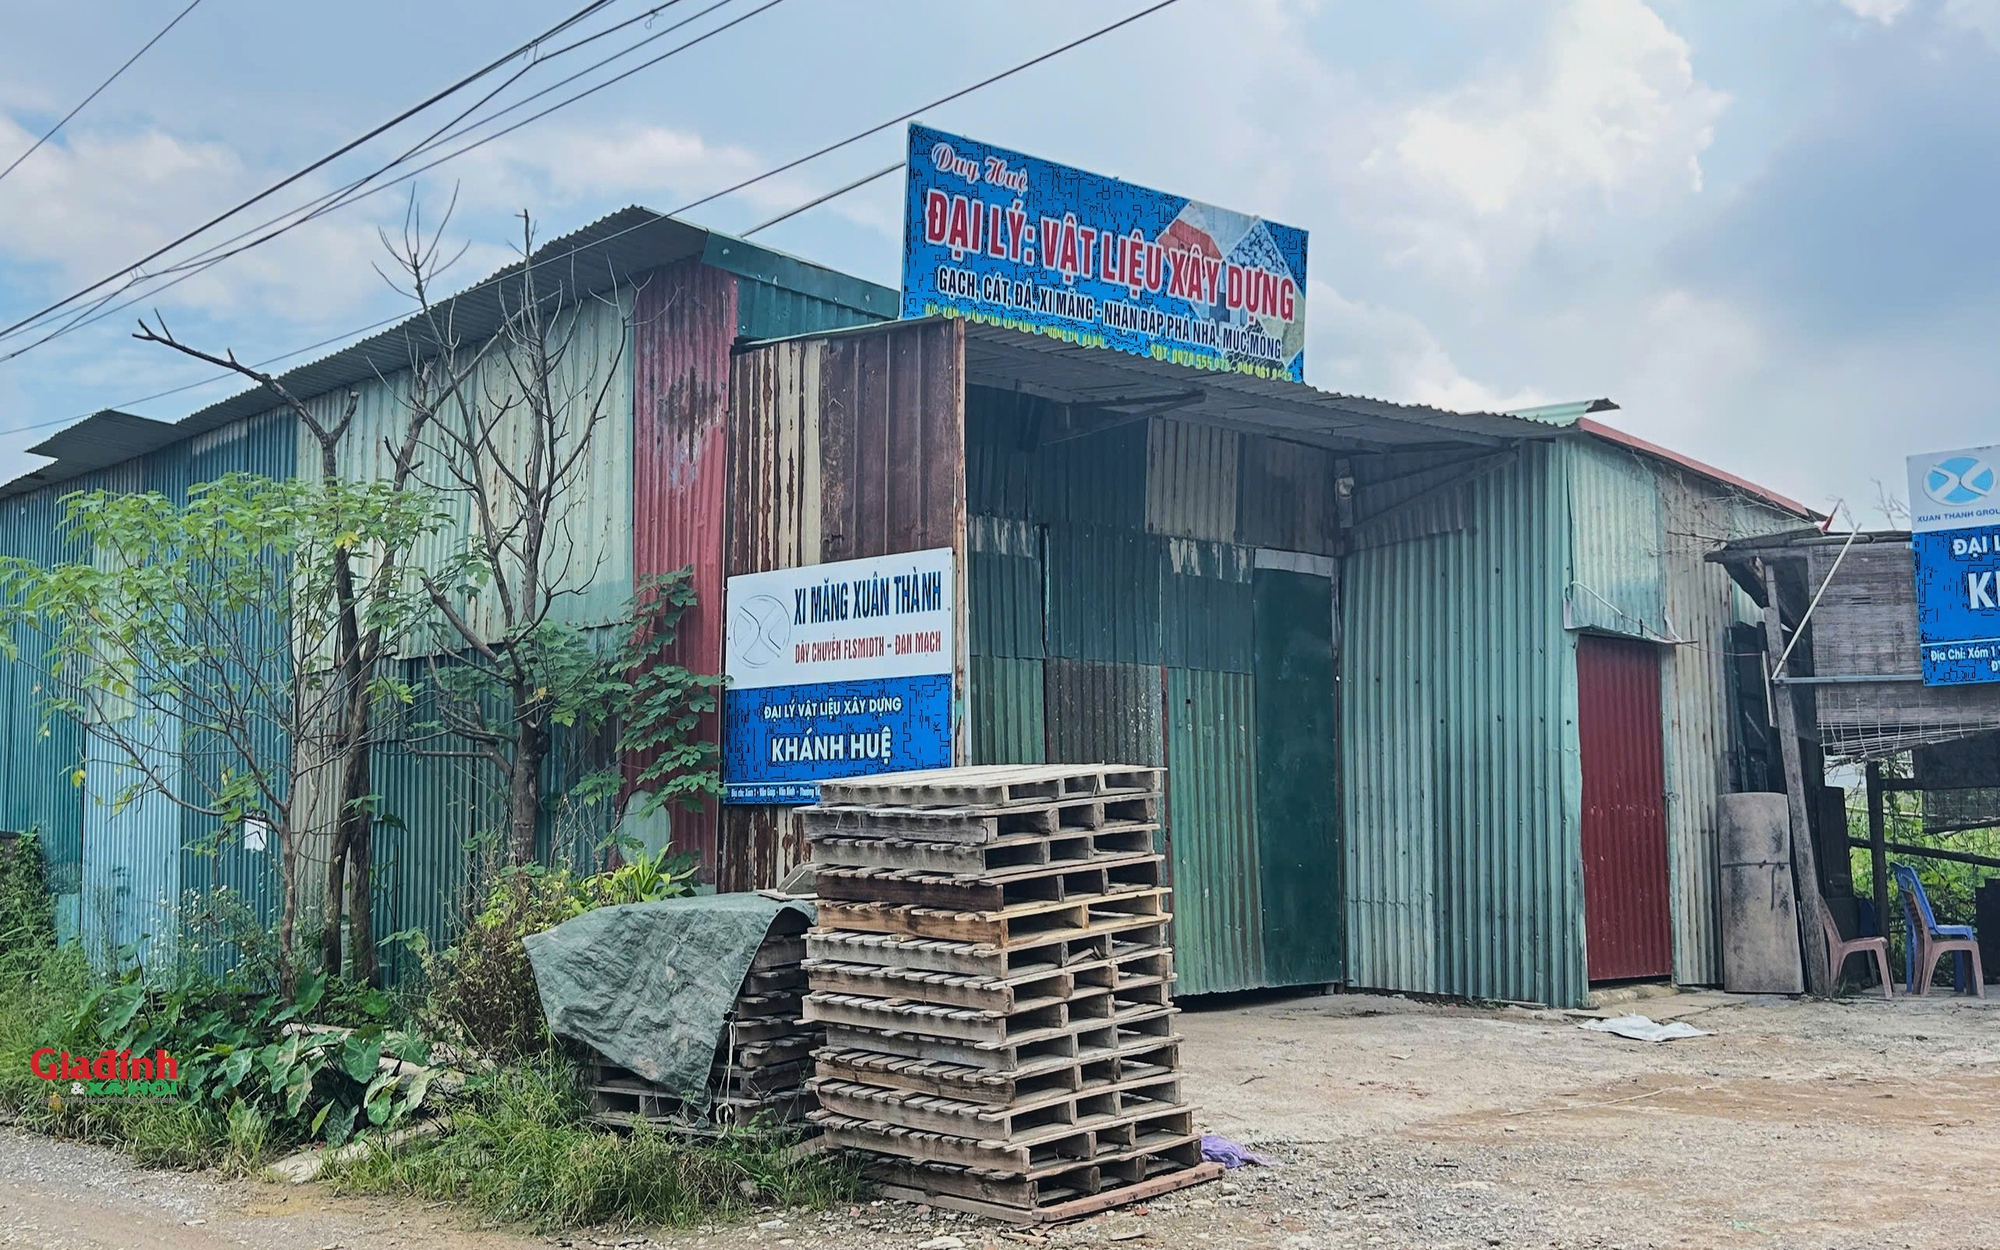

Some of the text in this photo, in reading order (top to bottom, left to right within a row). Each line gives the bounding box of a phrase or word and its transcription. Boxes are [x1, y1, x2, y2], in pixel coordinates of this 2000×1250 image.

[932, 143, 1028, 196] Duy Huệ
[927, 190, 1295, 323] ĐẠI LÝ: VẬT LIỆU XÂY DỰNG
[939, 267, 980, 301] GẠCH,
[983, 273, 1011, 308] CÁT,
[1014, 280, 1036, 312] ĐÁ,
[1040, 287, 1053, 312] XI
[1056, 289, 1093, 321] MĂNG
[1104, 301, 1138, 334] NHẬN
[1140, 307, 1163, 339] ĐẬP
[1166, 315, 1190, 342] PHÁ
[1193, 318, 1221, 350] NHÀ,
[1222, 324, 1248, 352] MÚC
[1250, 330, 1282, 360] MÓNG
[1917, 515, 1941, 523] XUAN
[1944, 510, 1974, 520] THANH
[1953, 535, 1988, 558] ĐẠI
[794, 566, 942, 626] XI MĂNG XUÂN THÀNH
[794, 639, 809, 664] DÂY
[843, 636, 885, 660] FLSMIDTH
[894, 633, 912, 656] ĐAN
[915, 630, 942, 657] MẠCH
[1967, 646, 1989, 659] Xóm
[763, 695, 902, 723] ĐẠI LÝ VẬT LIỆU XÂY DỰNG
[771, 725, 892, 765] KHÁNH HUỆ
